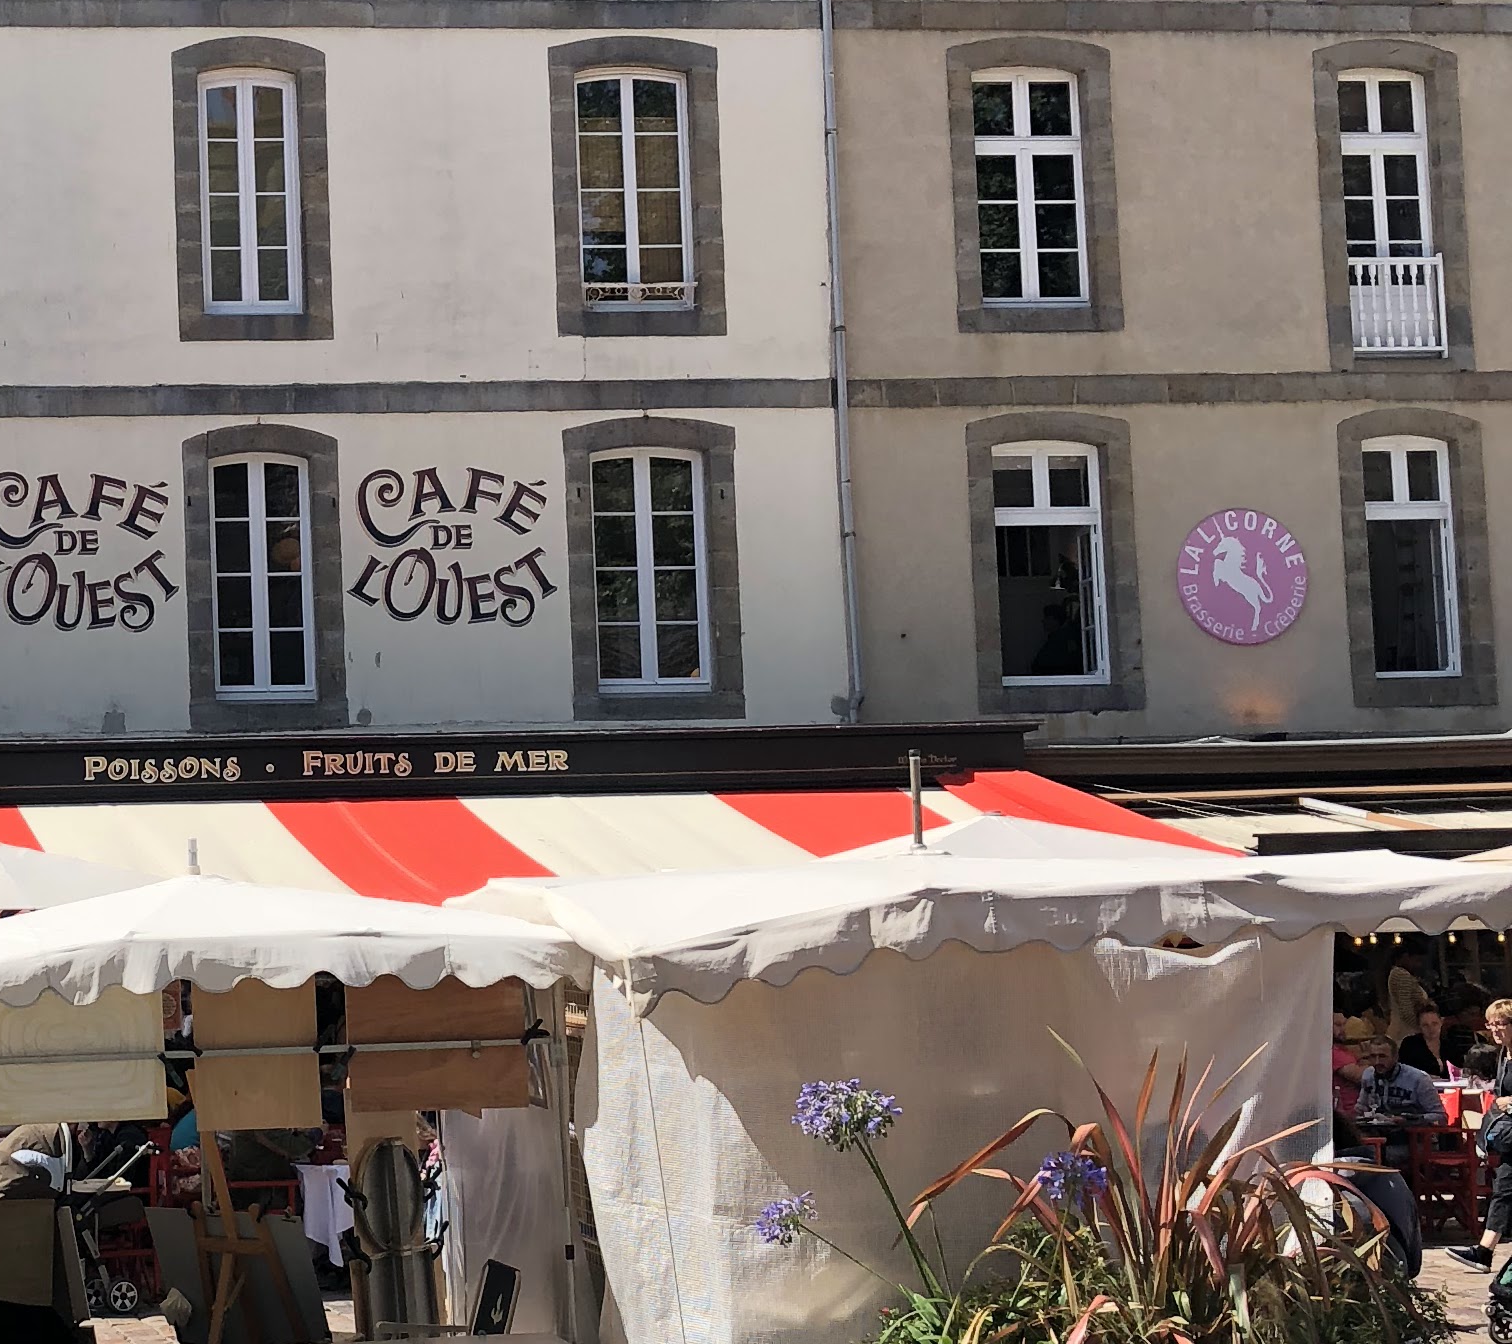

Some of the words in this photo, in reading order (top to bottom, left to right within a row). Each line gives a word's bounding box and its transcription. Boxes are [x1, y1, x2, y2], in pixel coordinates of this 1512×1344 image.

[355, 467, 547, 548] CAFÉ
[53, 530, 99, 556] DE
[428, 524, 473, 550] DE
[1180, 545, 1204, 575] LA
[346, 546, 558, 628] L'OUEST
[1183, 584, 1245, 641] Brasserie
[1264, 575, 1306, 636] Crêperie
[83, 756, 241, 783] POISSONS
[302, 750, 412, 777] FRUITS
[433, 751, 477, 773] DE
[493, 749, 569, 772] MER
